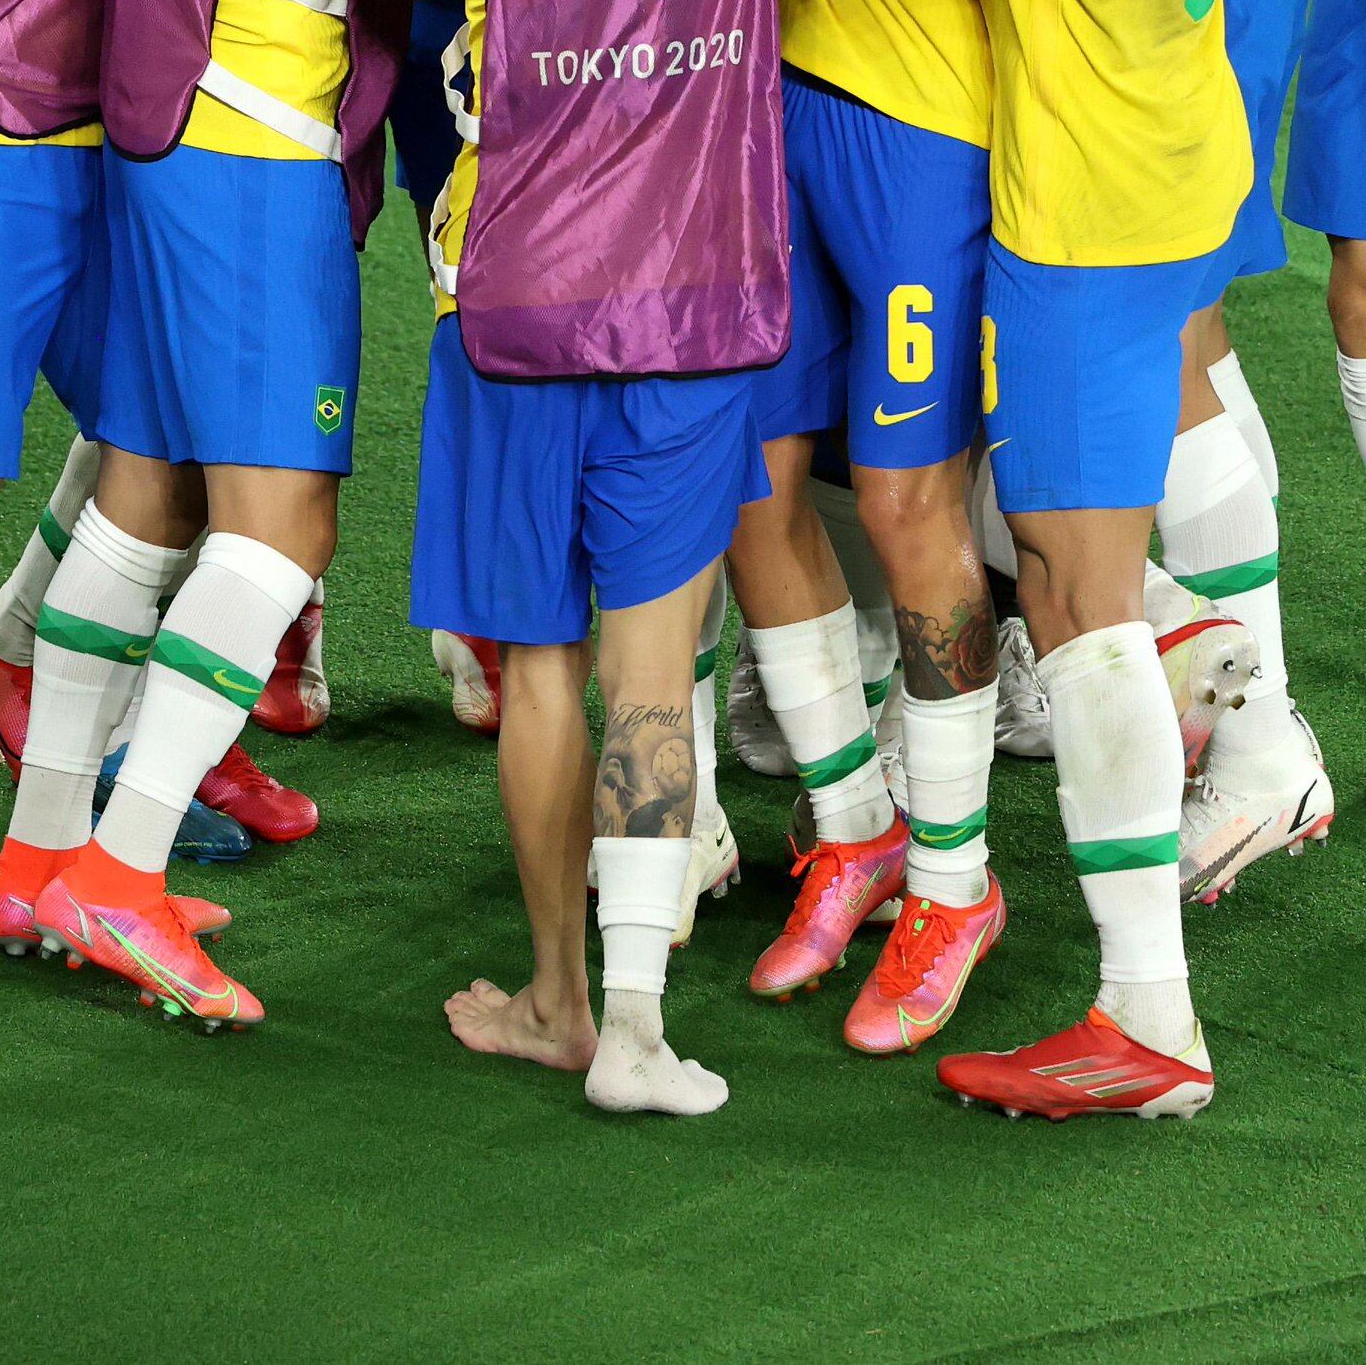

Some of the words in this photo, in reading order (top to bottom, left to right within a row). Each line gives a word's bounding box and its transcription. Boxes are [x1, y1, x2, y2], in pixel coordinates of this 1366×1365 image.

[531, 43, 655, 86] TOKYO
[665, 28, 744, 77] 2020
[887, 284, 934, 384] 6
